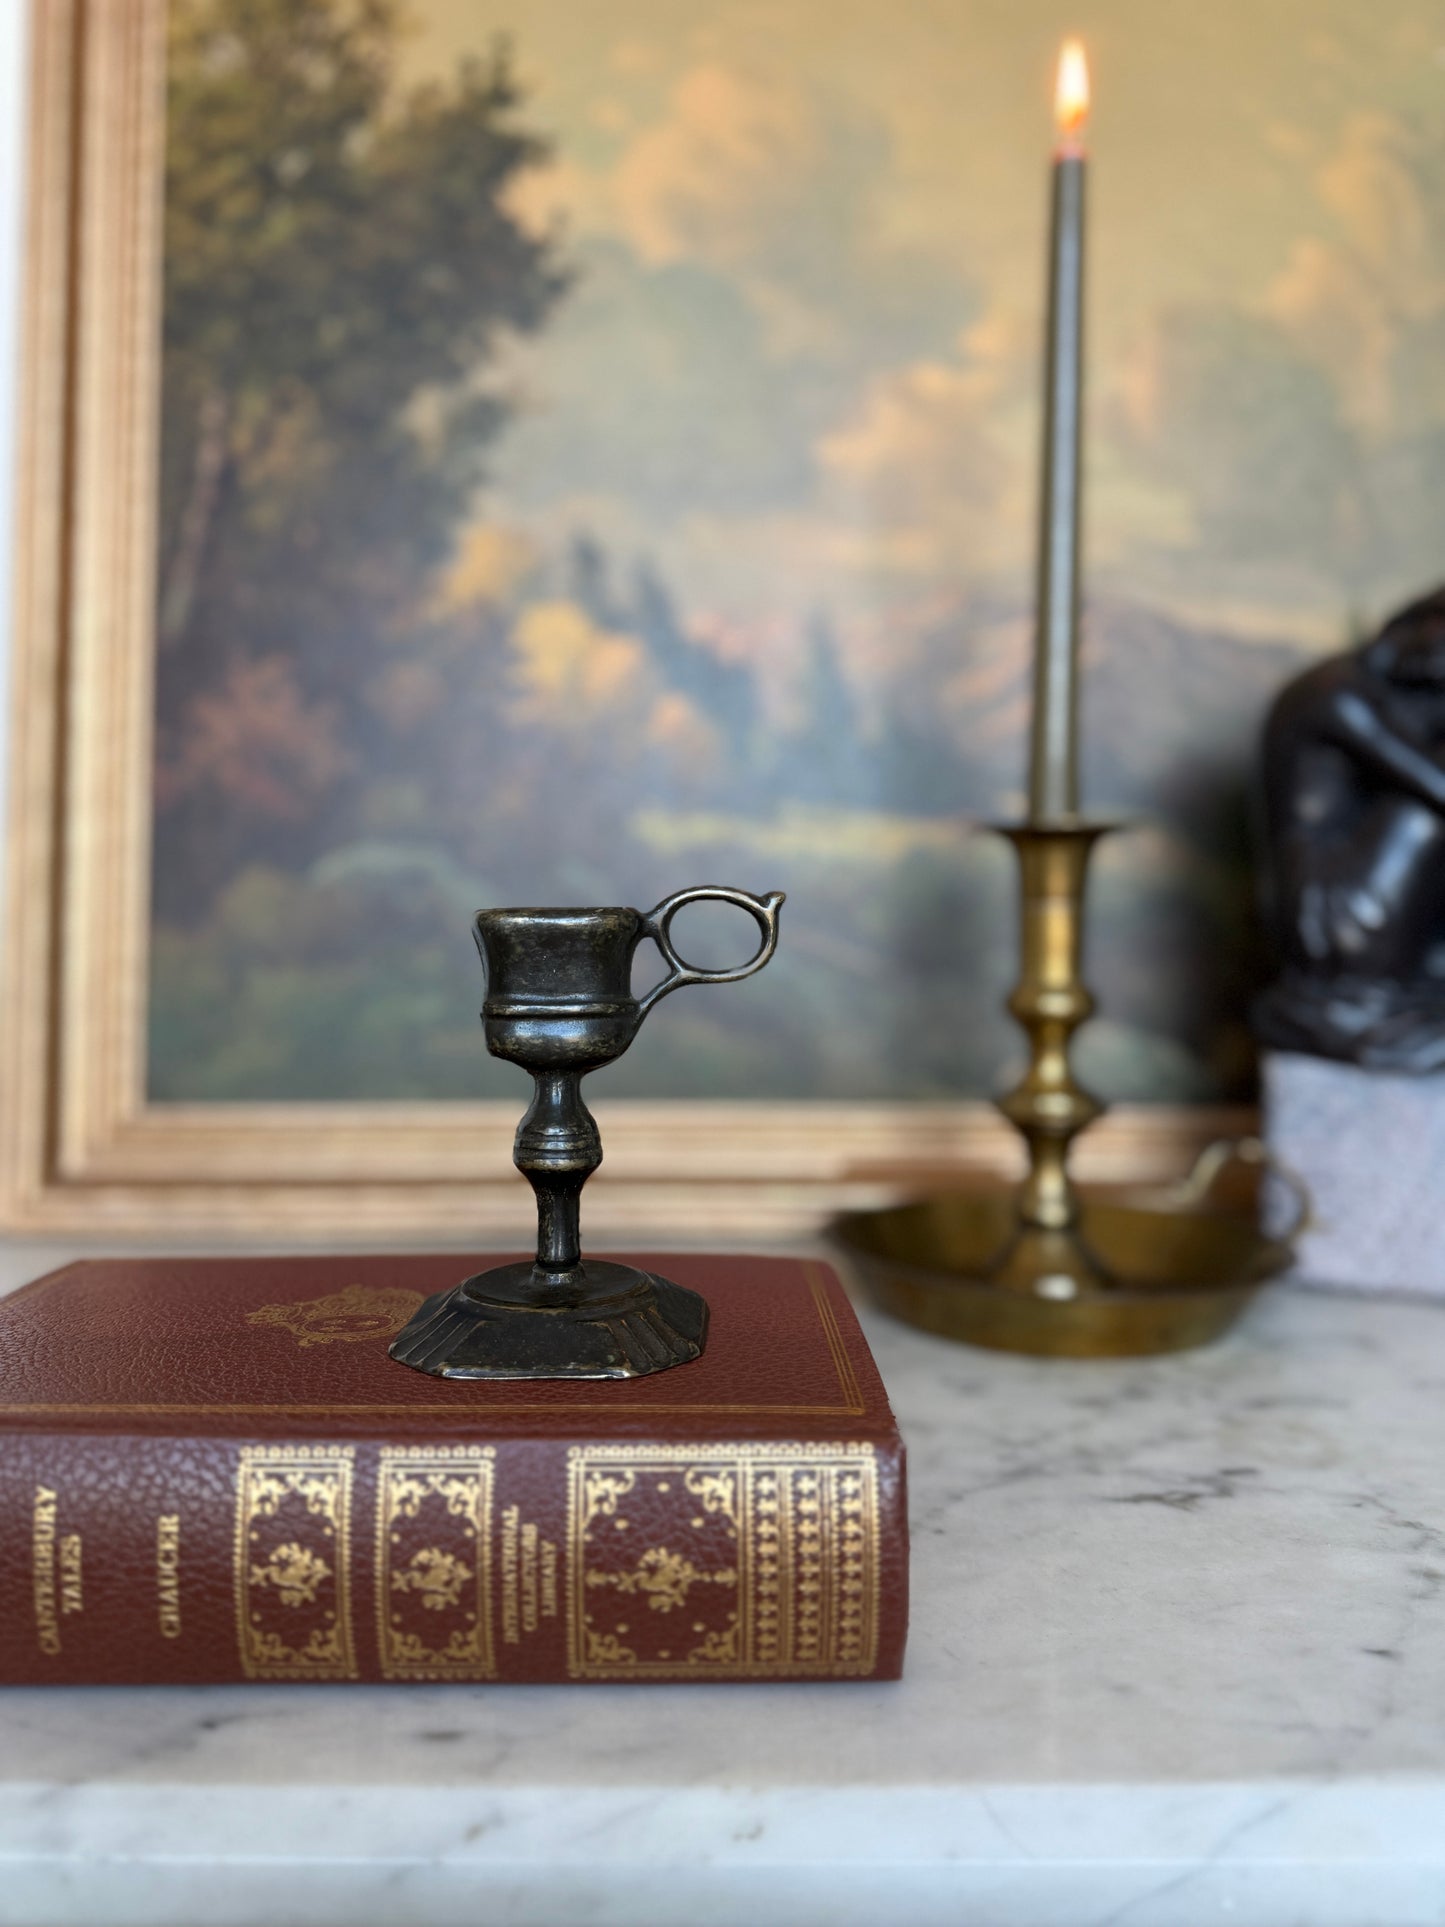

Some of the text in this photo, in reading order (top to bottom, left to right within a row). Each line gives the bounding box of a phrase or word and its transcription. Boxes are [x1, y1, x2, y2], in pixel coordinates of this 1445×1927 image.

[34, 1485, 60, 1654] CANTERBURY
[60, 1534, 83, 1614] TALES
[157, 1513, 181, 1638] CHAUCER
[501, 1504, 519, 1643] INTERNATIONAL
[521, 1522, 538, 1632] COLLECTORS
[541, 1538, 556, 1616] LIBRARY
